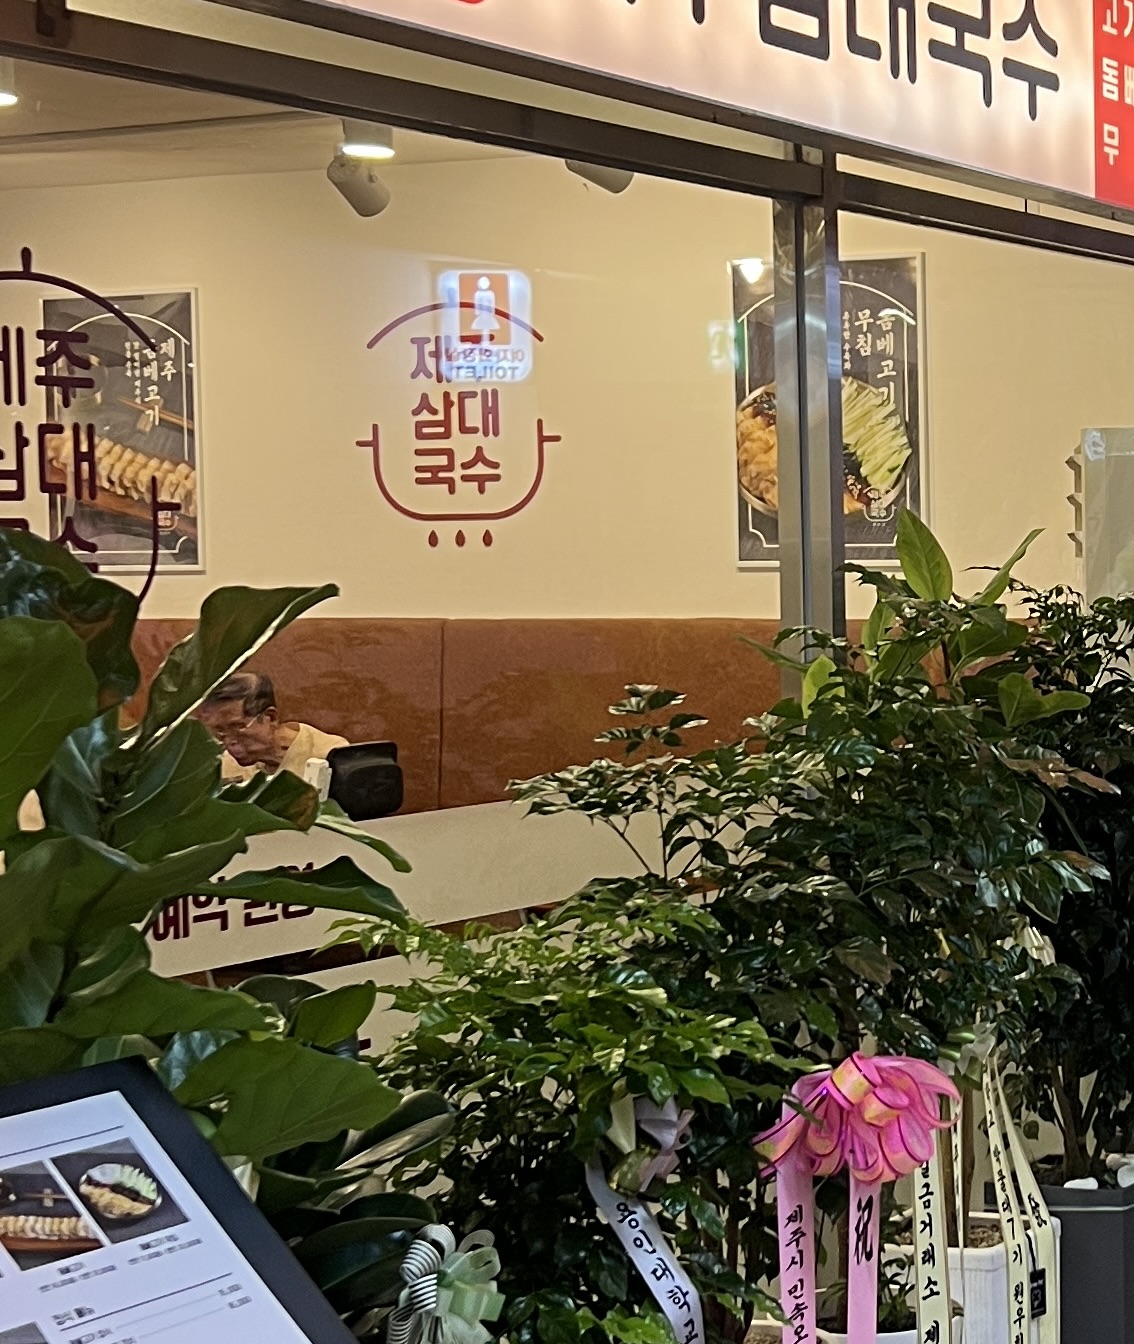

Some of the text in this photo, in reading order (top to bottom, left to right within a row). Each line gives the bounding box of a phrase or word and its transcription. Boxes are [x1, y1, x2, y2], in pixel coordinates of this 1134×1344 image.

[854, 308, 875, 356] 무침
[411, 388, 500, 441] 삼대
[414, 445, 502, 496] 국수
[783, 1203, 807, 1273] 제주시
